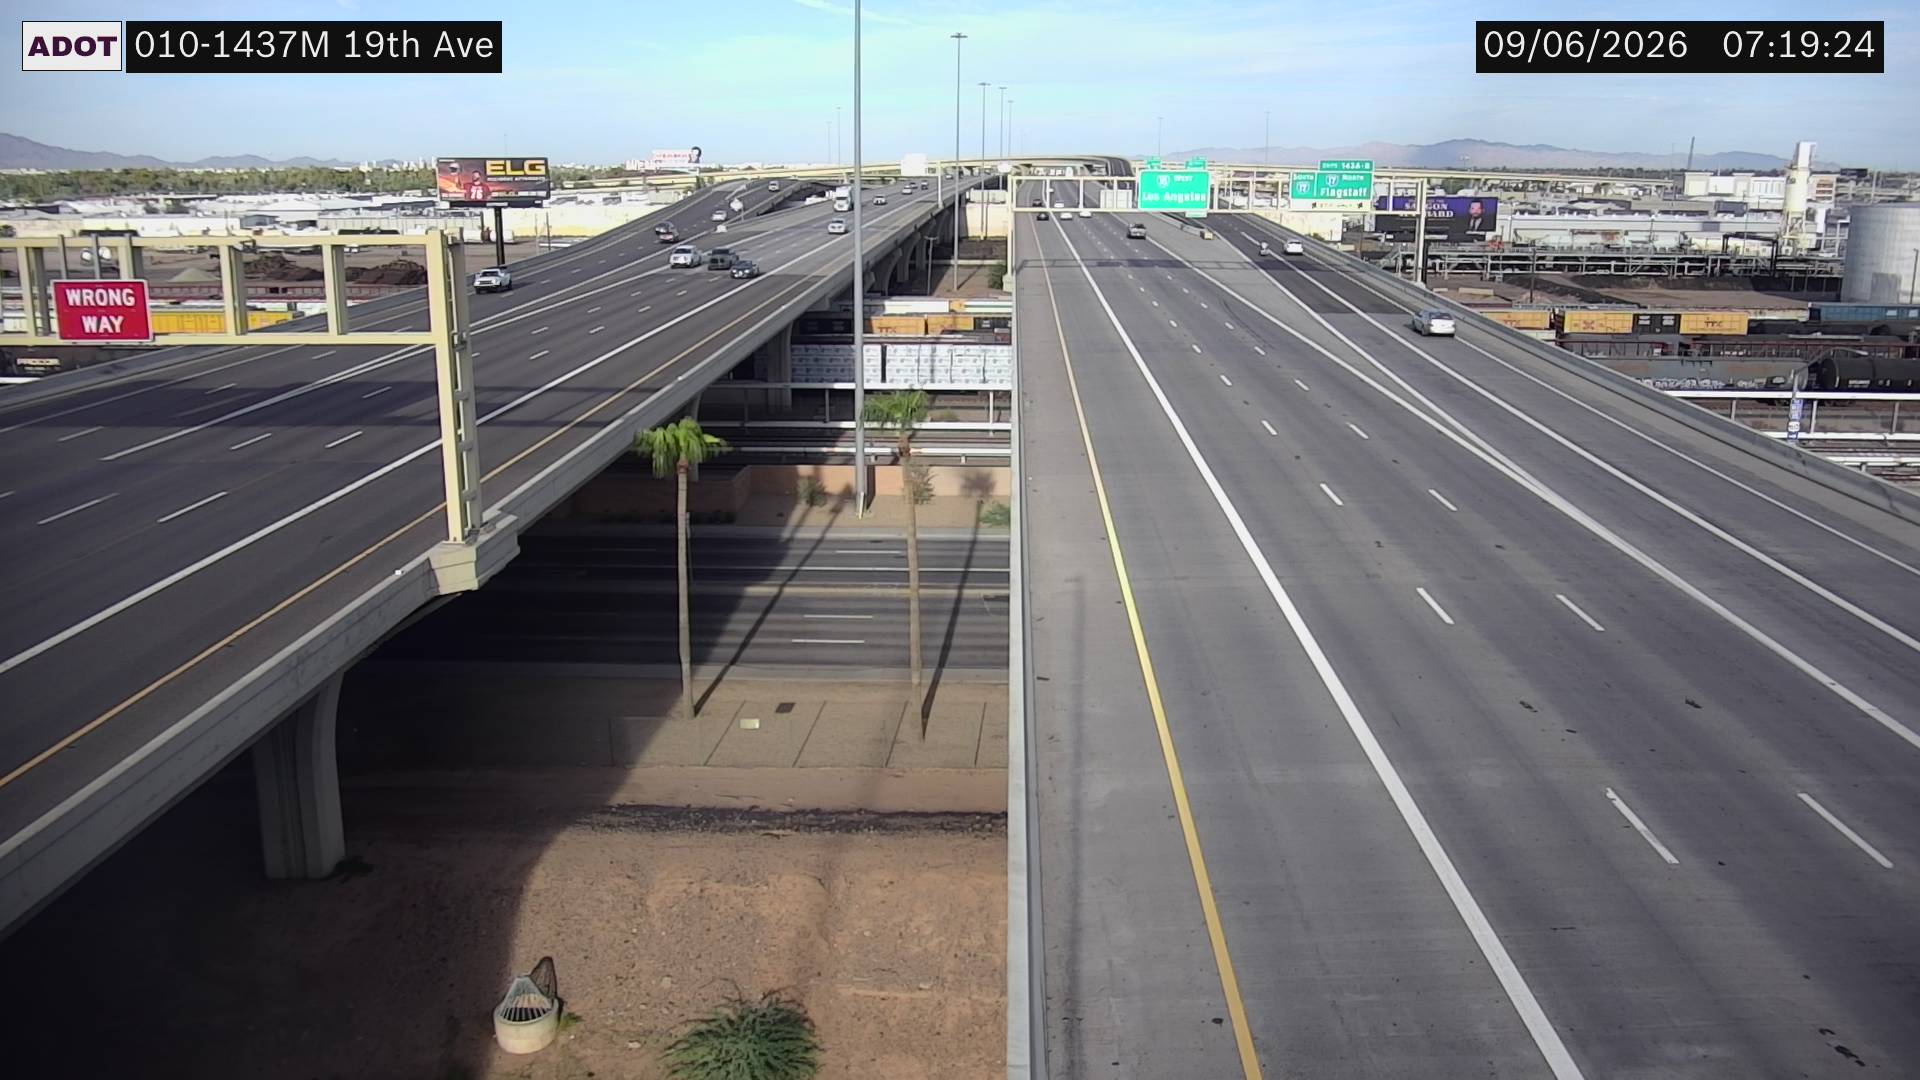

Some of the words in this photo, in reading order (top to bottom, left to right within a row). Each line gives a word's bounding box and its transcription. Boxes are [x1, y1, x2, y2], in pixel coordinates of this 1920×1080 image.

[486, 160, 546, 176] ELG
[1142, 191, 1160, 201] Los
[1164, 191, 1206, 204] Angeles
[1320, 187, 1367, 198] Flagstaff
[65, 288, 136, 307] WRONG
[81, 315, 124, 334] WAY
